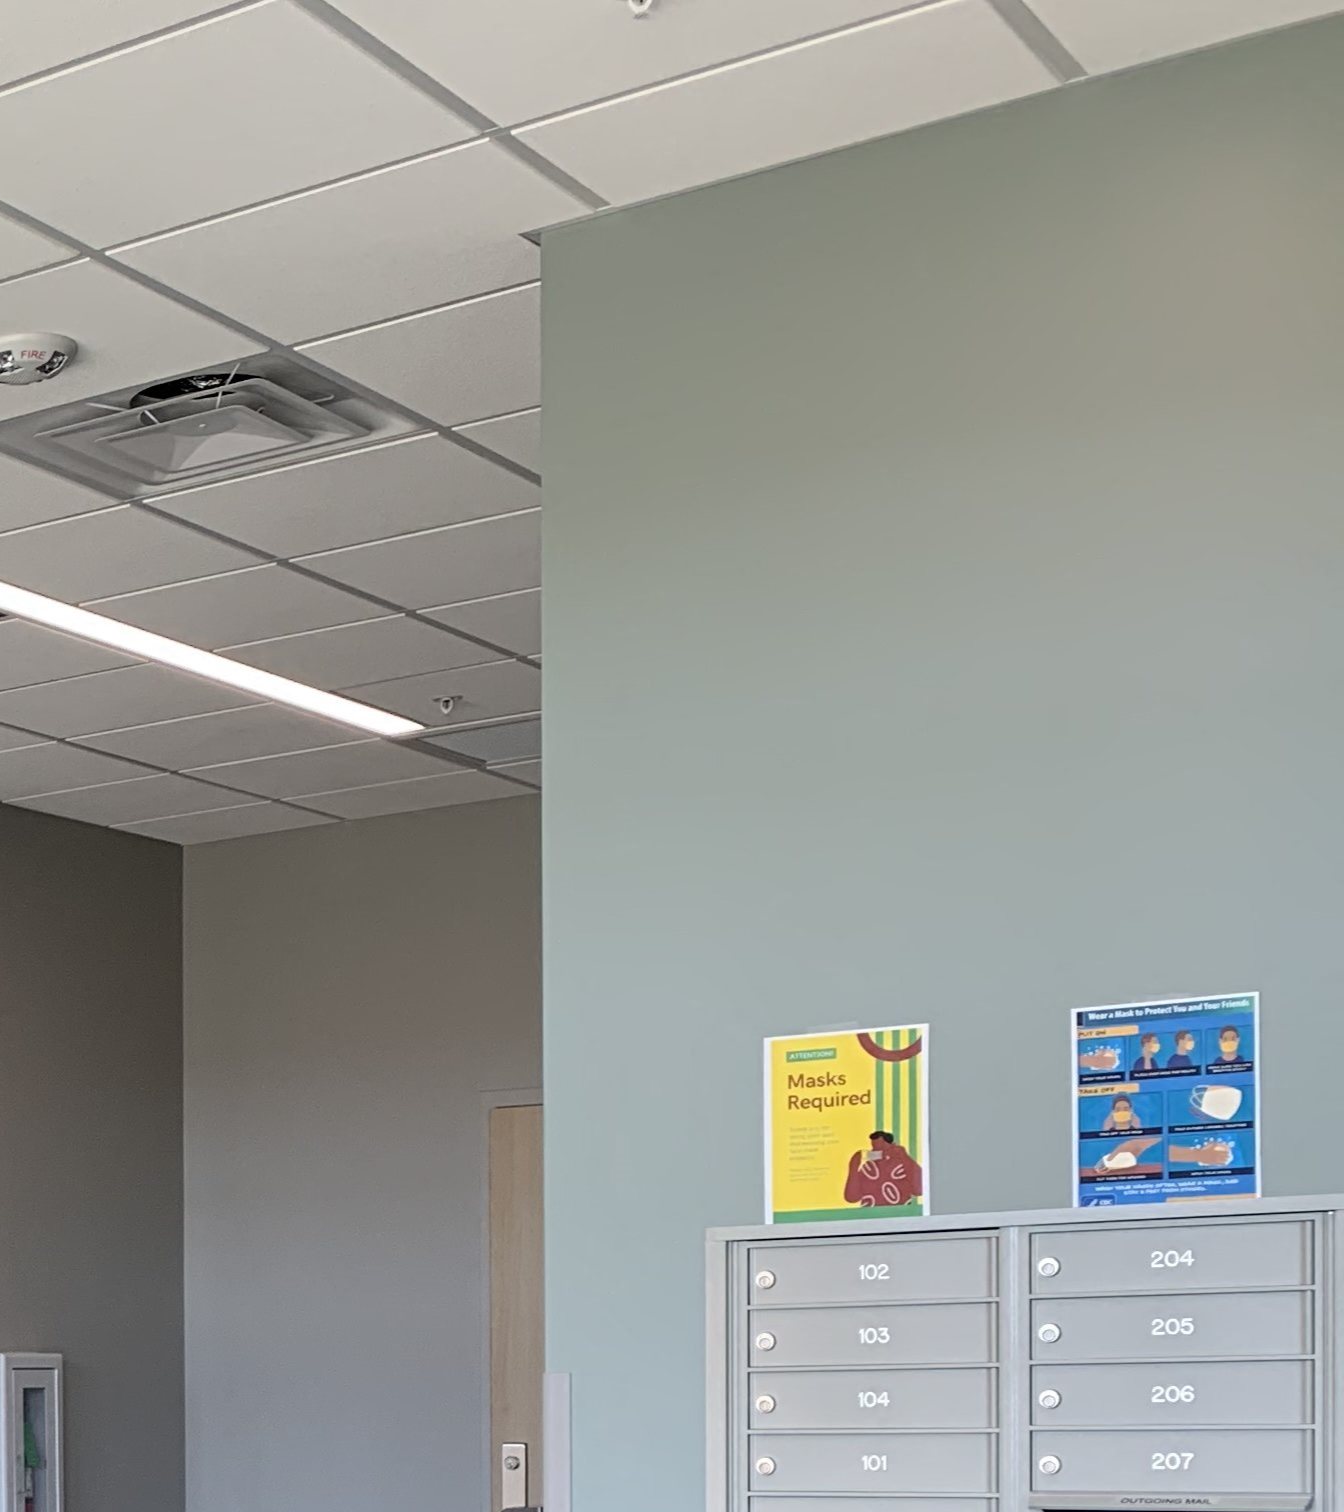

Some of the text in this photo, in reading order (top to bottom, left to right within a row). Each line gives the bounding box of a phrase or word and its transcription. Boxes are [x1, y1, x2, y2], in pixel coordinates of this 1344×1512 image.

[21, 350, 46, 360] FIRE
[1222, 1000, 1249, 1008] Friends
[788, 1072, 846, 1089] Masks
[788, 1090, 871, 1112] Required
[1151, 1250, 1195, 1268] 204
[859, 1264, 890, 1280] 102
[1151, 1318, 1194, 1336] 205
[859, 1328, 890, 1344] 103
[858, 1392, 890, 1408] 104
[1151, 1386, 1195, 1403] 206
[862, 1455, 888, 1471] 101
[1151, 1453, 1194, 1470] 207
